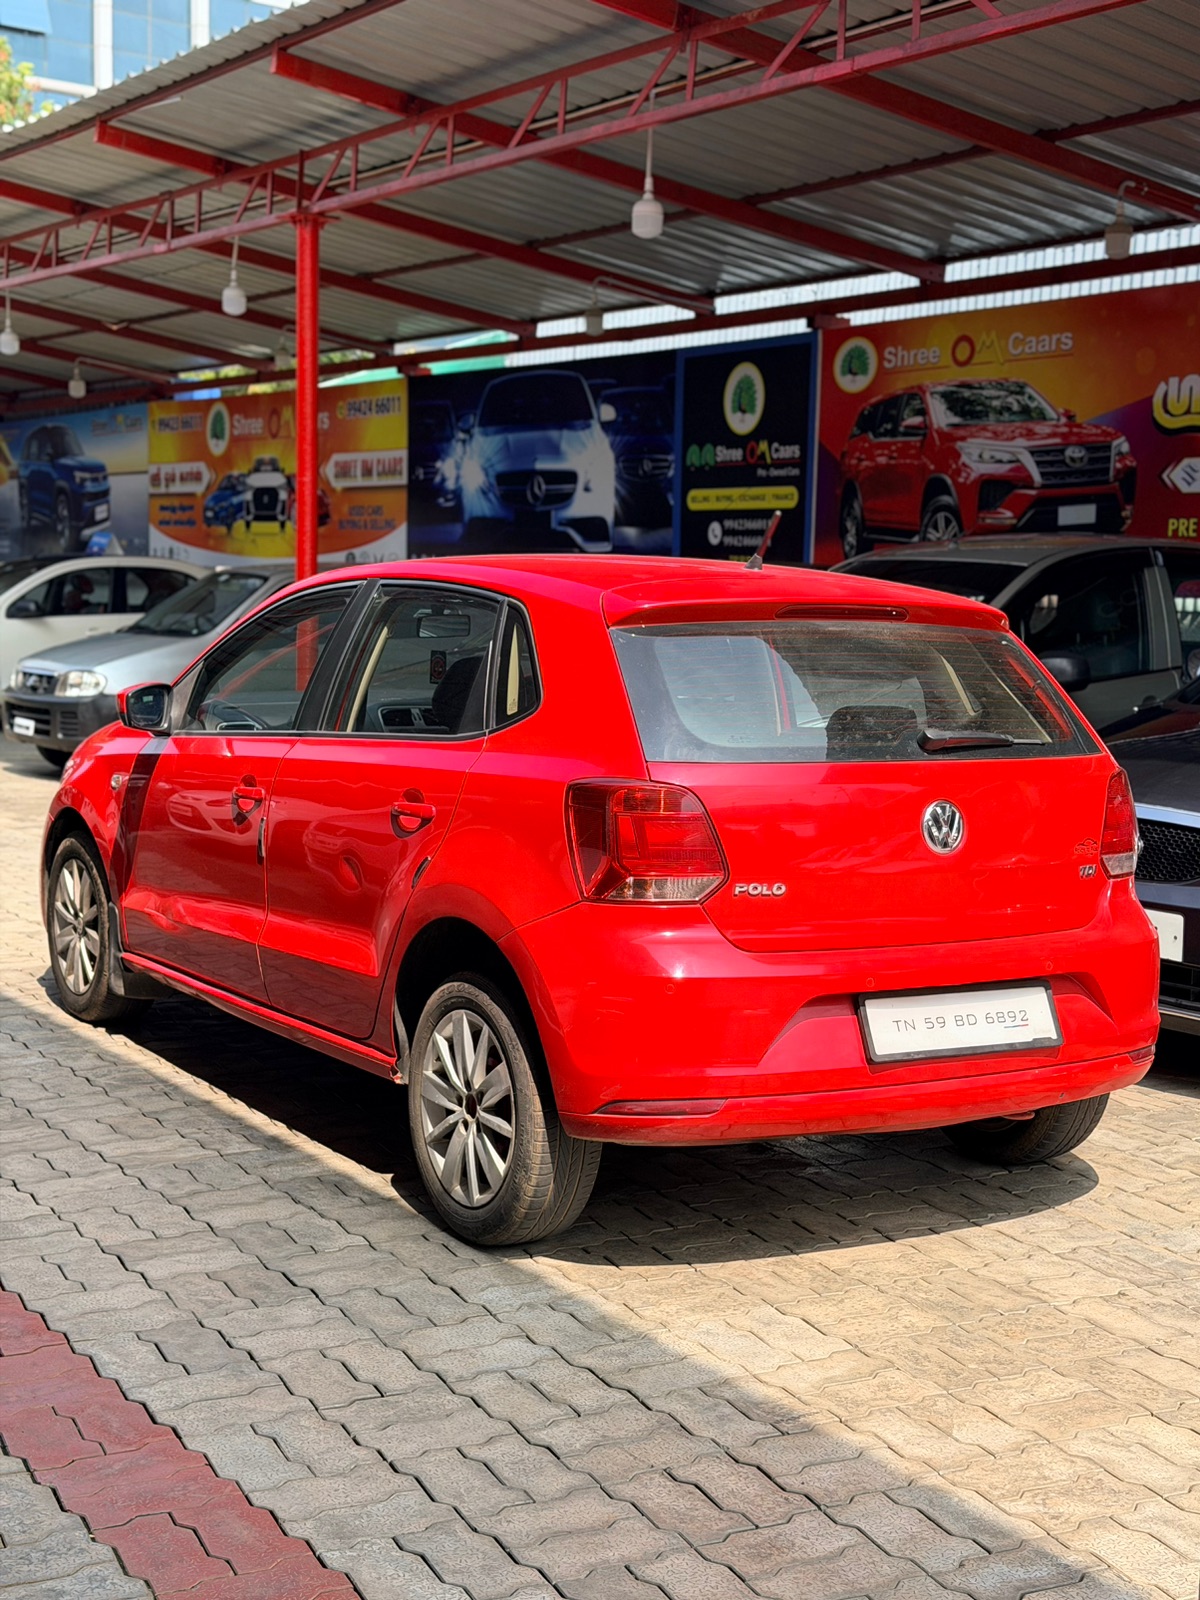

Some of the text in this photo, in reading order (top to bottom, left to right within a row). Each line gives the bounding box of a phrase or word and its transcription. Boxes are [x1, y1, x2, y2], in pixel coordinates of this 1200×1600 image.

[883, 331, 1074, 369] Shree OM Caars
[232, 413, 264, 436] Shree
[715, 439, 800, 465] Shree OM Caars
[1167, 517, 1198, 538] PRE
[733, 882, 786, 897] POLO
[892, 1009, 1029, 1032] TN 59 BD 6892
